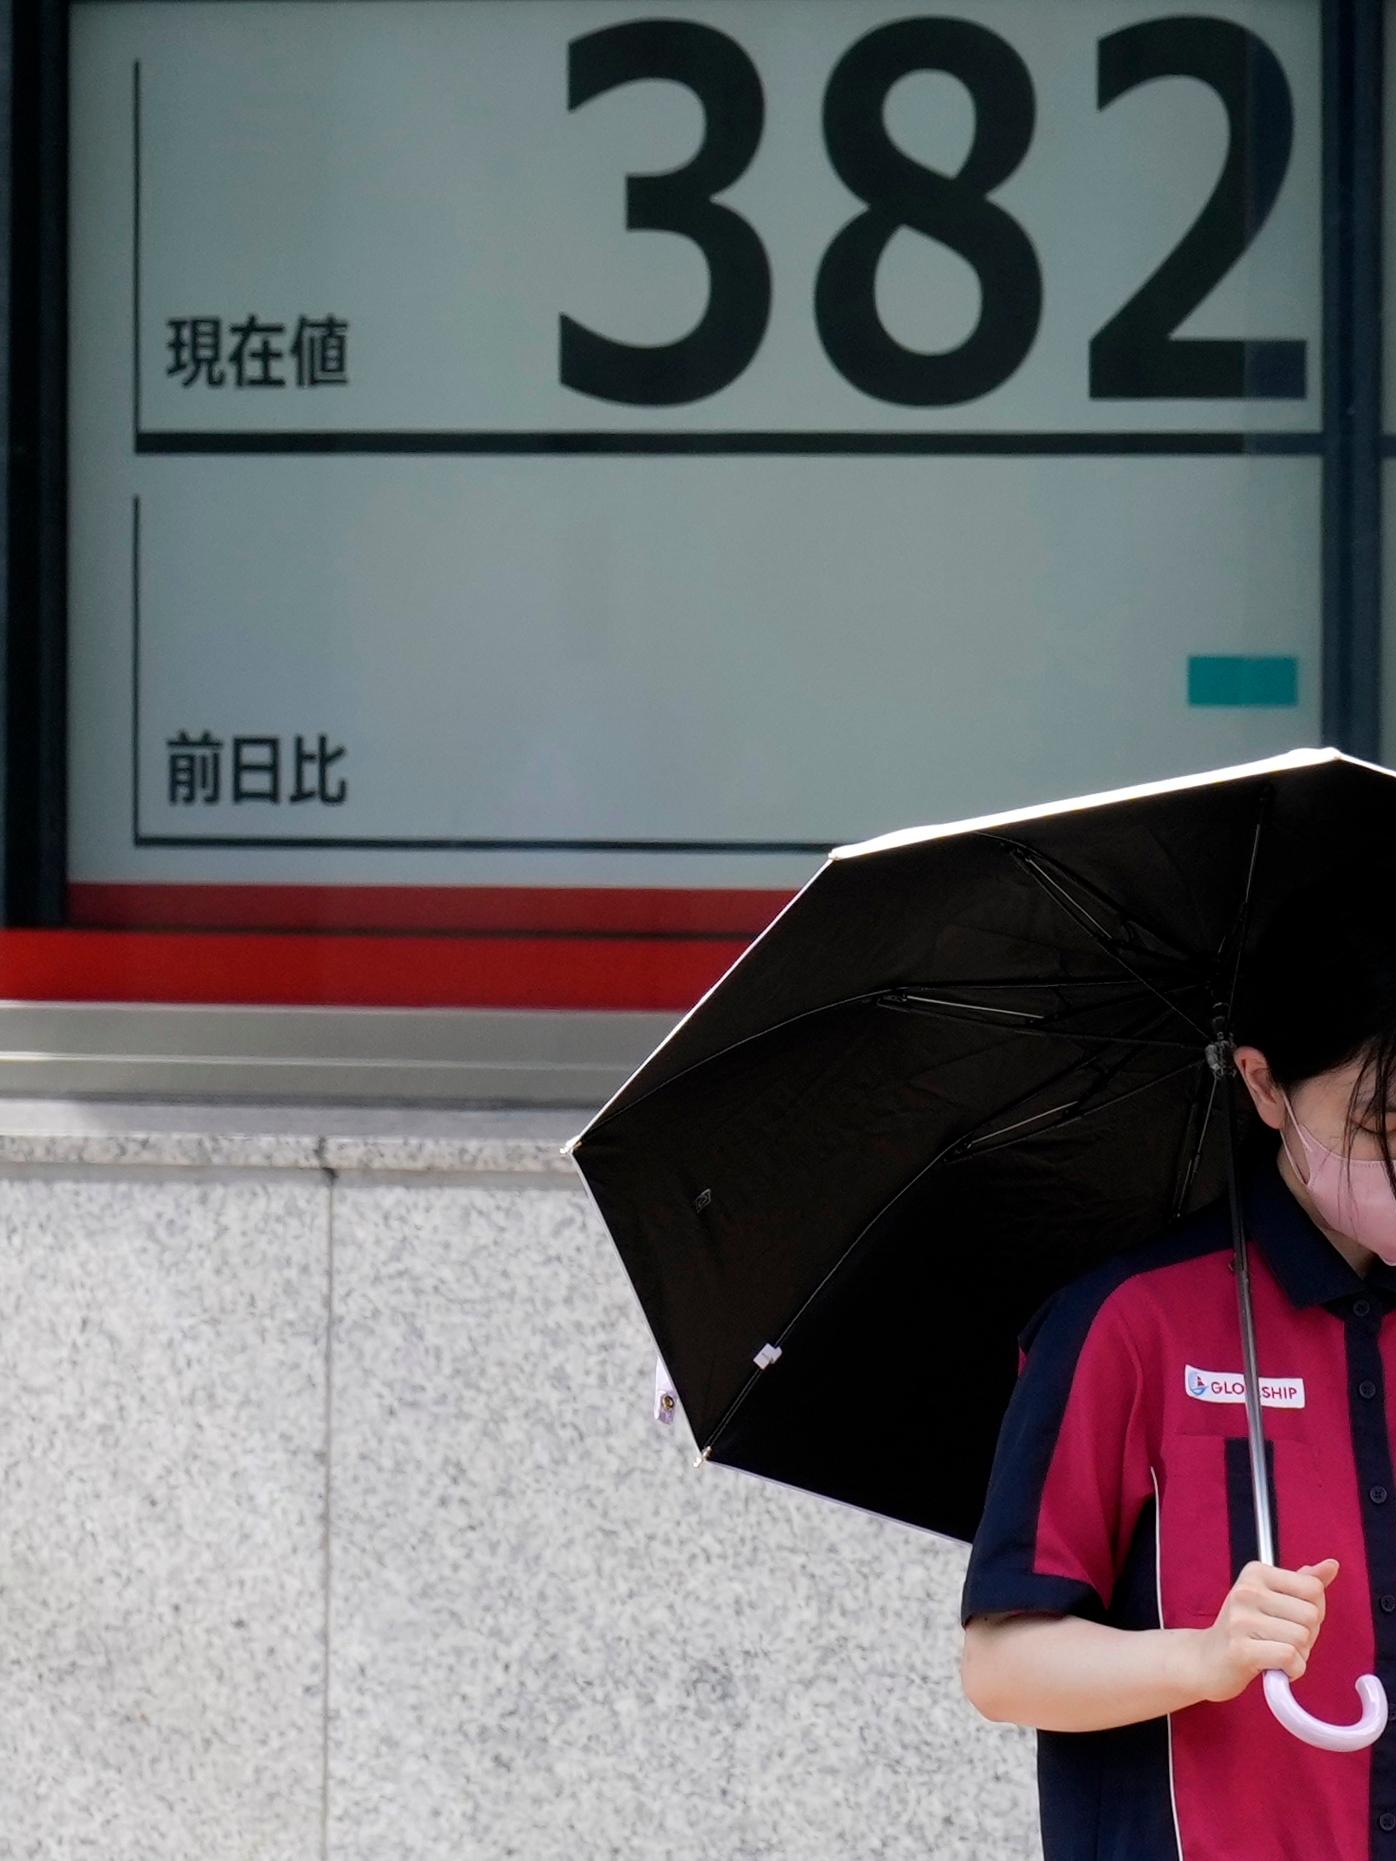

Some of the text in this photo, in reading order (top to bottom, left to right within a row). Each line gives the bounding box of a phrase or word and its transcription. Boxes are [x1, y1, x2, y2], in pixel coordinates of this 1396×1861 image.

[167, 314, 349, 387] 現在値
[167, 730, 347, 804] 前日比
[1210, 1381, 1298, 1400] GLOSHIP
